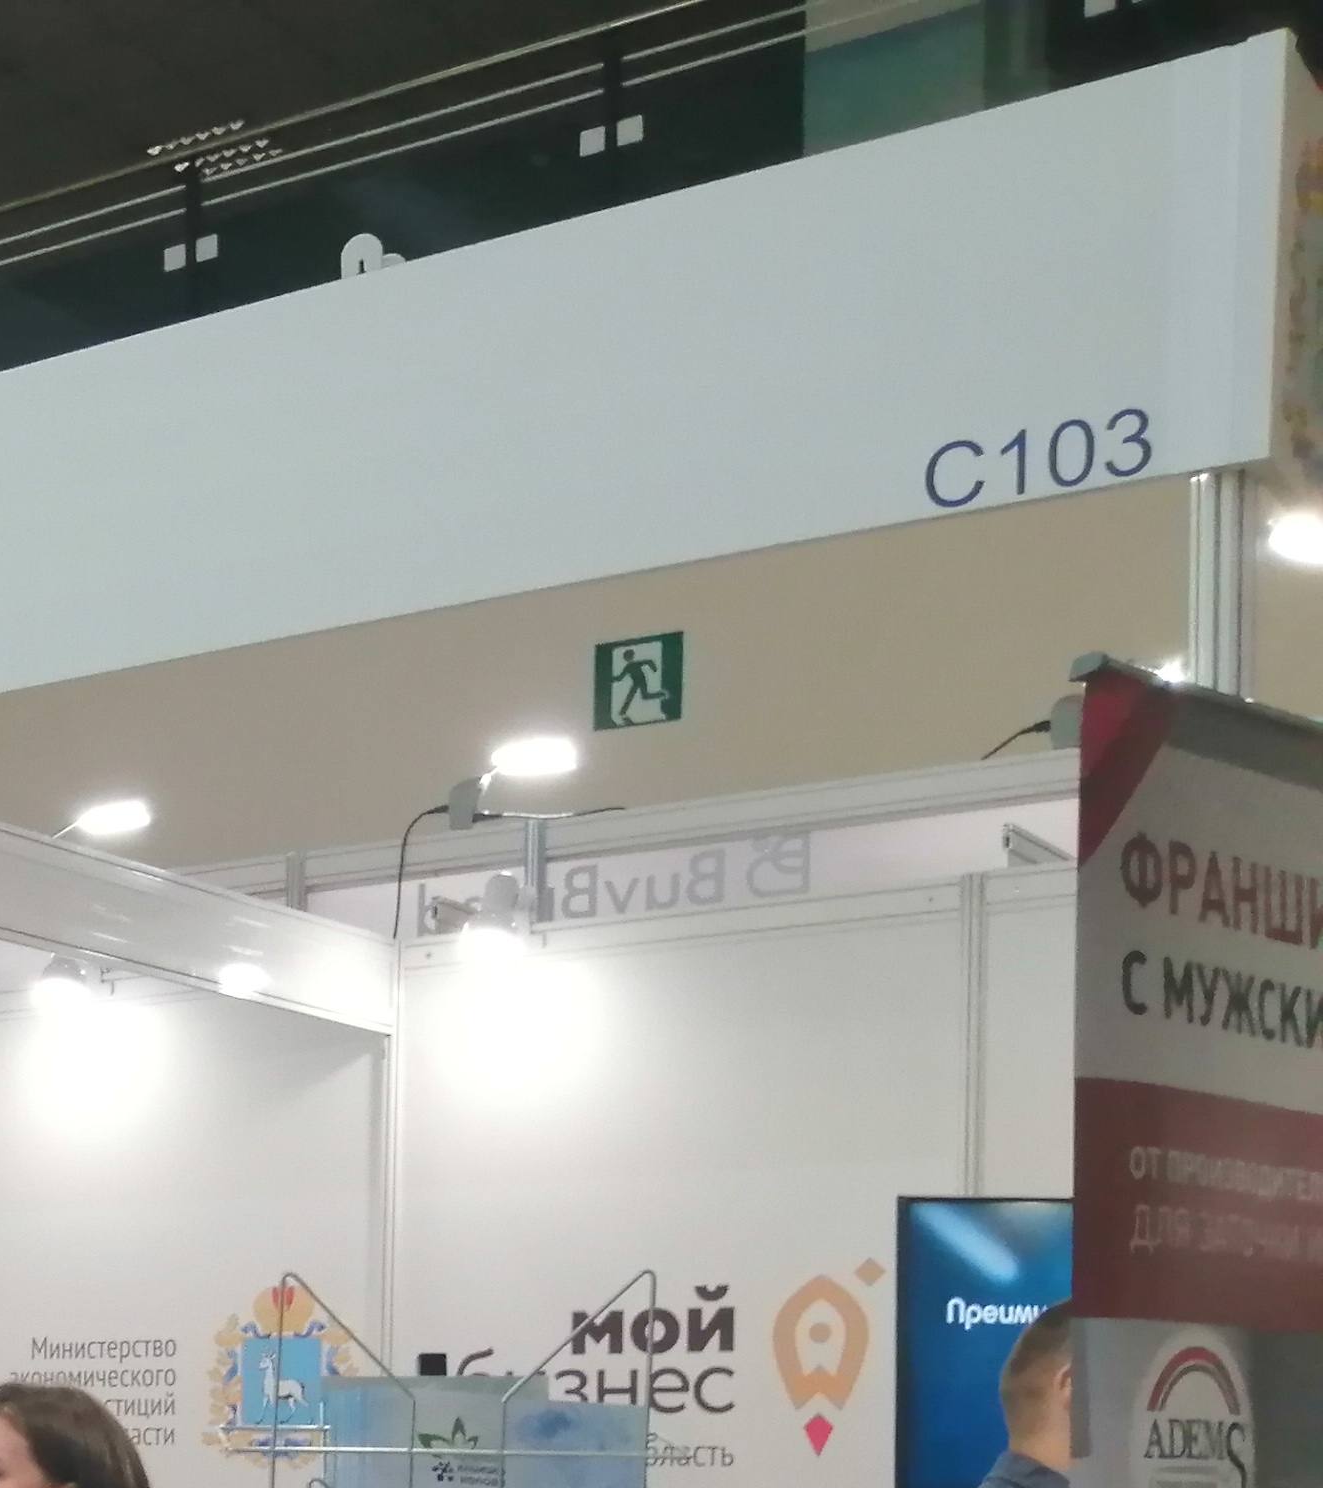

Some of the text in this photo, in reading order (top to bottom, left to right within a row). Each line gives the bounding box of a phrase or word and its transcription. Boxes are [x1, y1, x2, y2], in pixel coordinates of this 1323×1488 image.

[1121, 949, 1149, 1016] С
[30, 1336, 177, 1362] Министерство
[571, 1283, 736, 1356] мой
